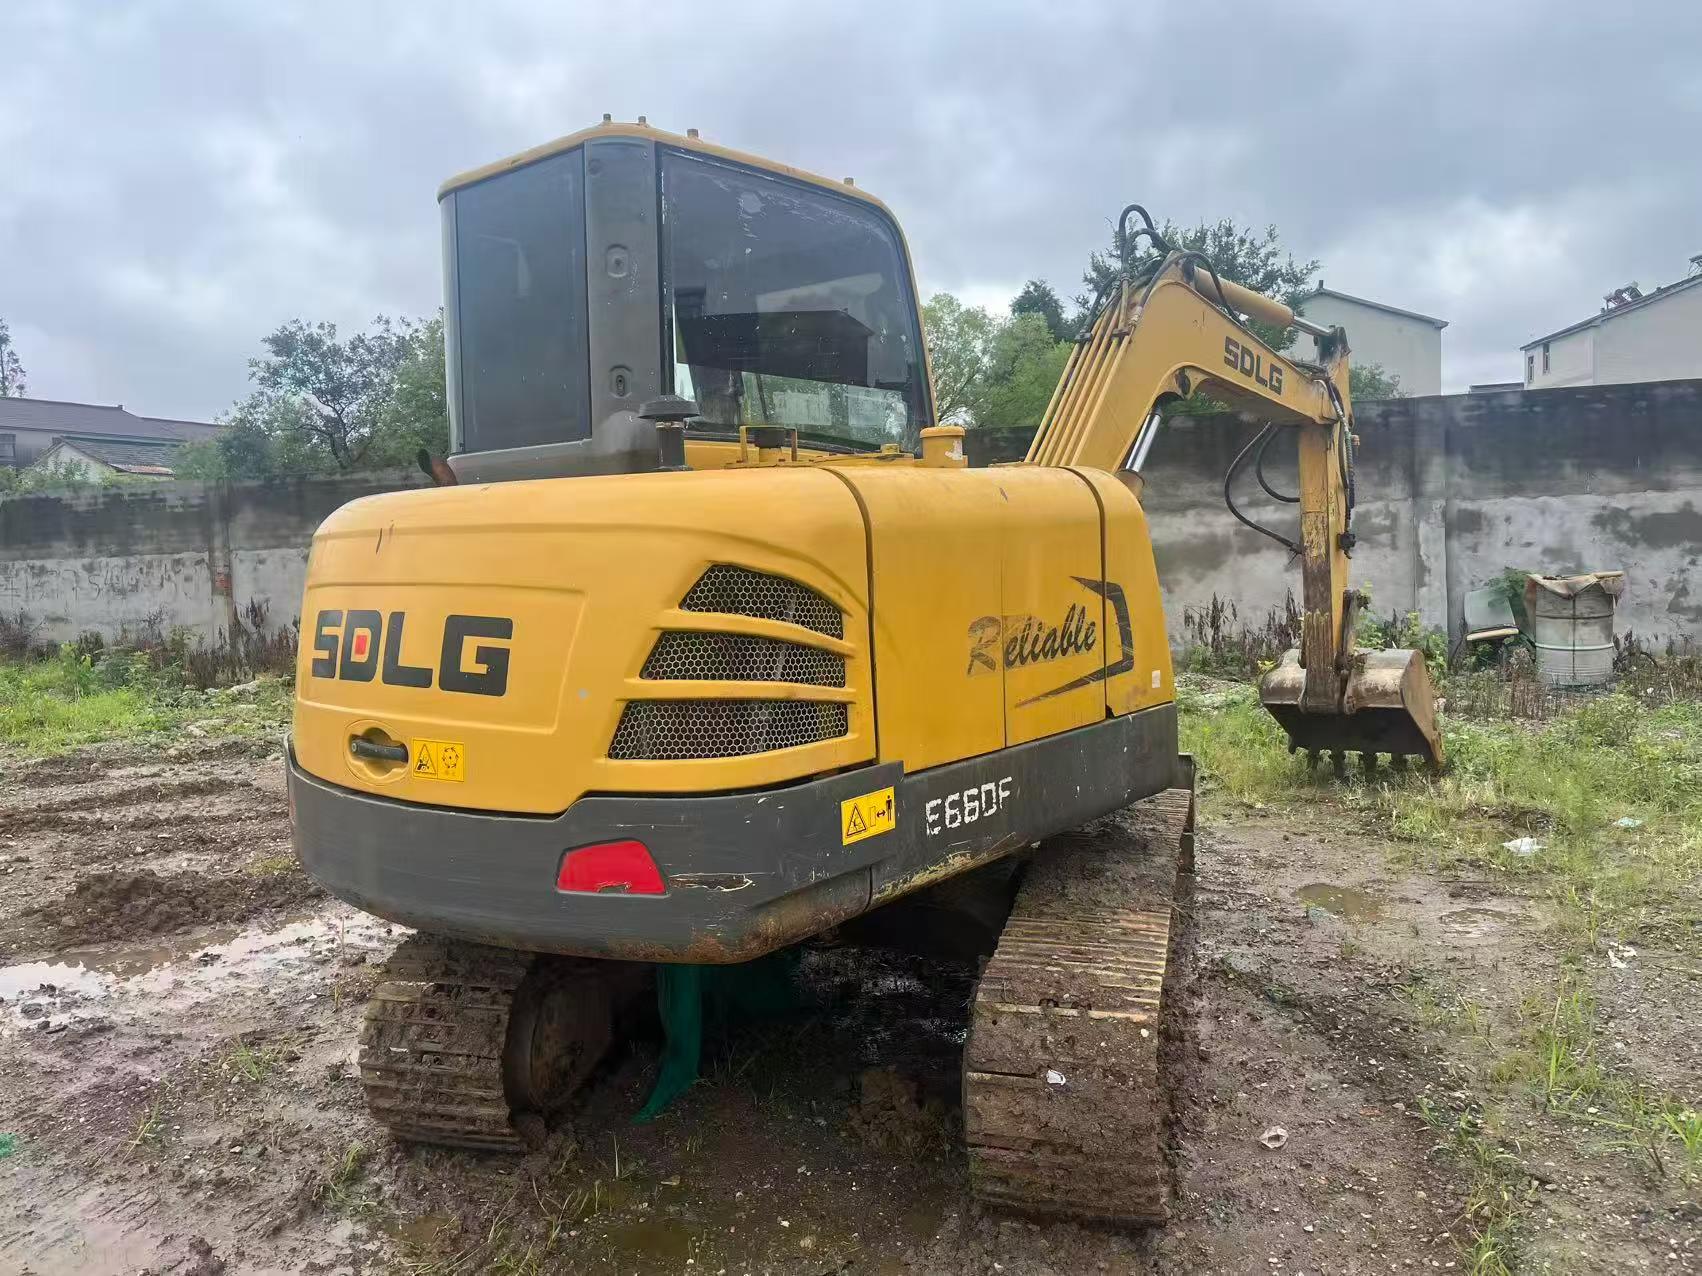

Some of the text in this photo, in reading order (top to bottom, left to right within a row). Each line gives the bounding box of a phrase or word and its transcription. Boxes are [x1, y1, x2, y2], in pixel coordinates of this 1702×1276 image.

[1224, 336, 1282, 395] SDLG
[312, 609, 513, 697] SDLG
[967, 603, 1096, 676] Reliable
